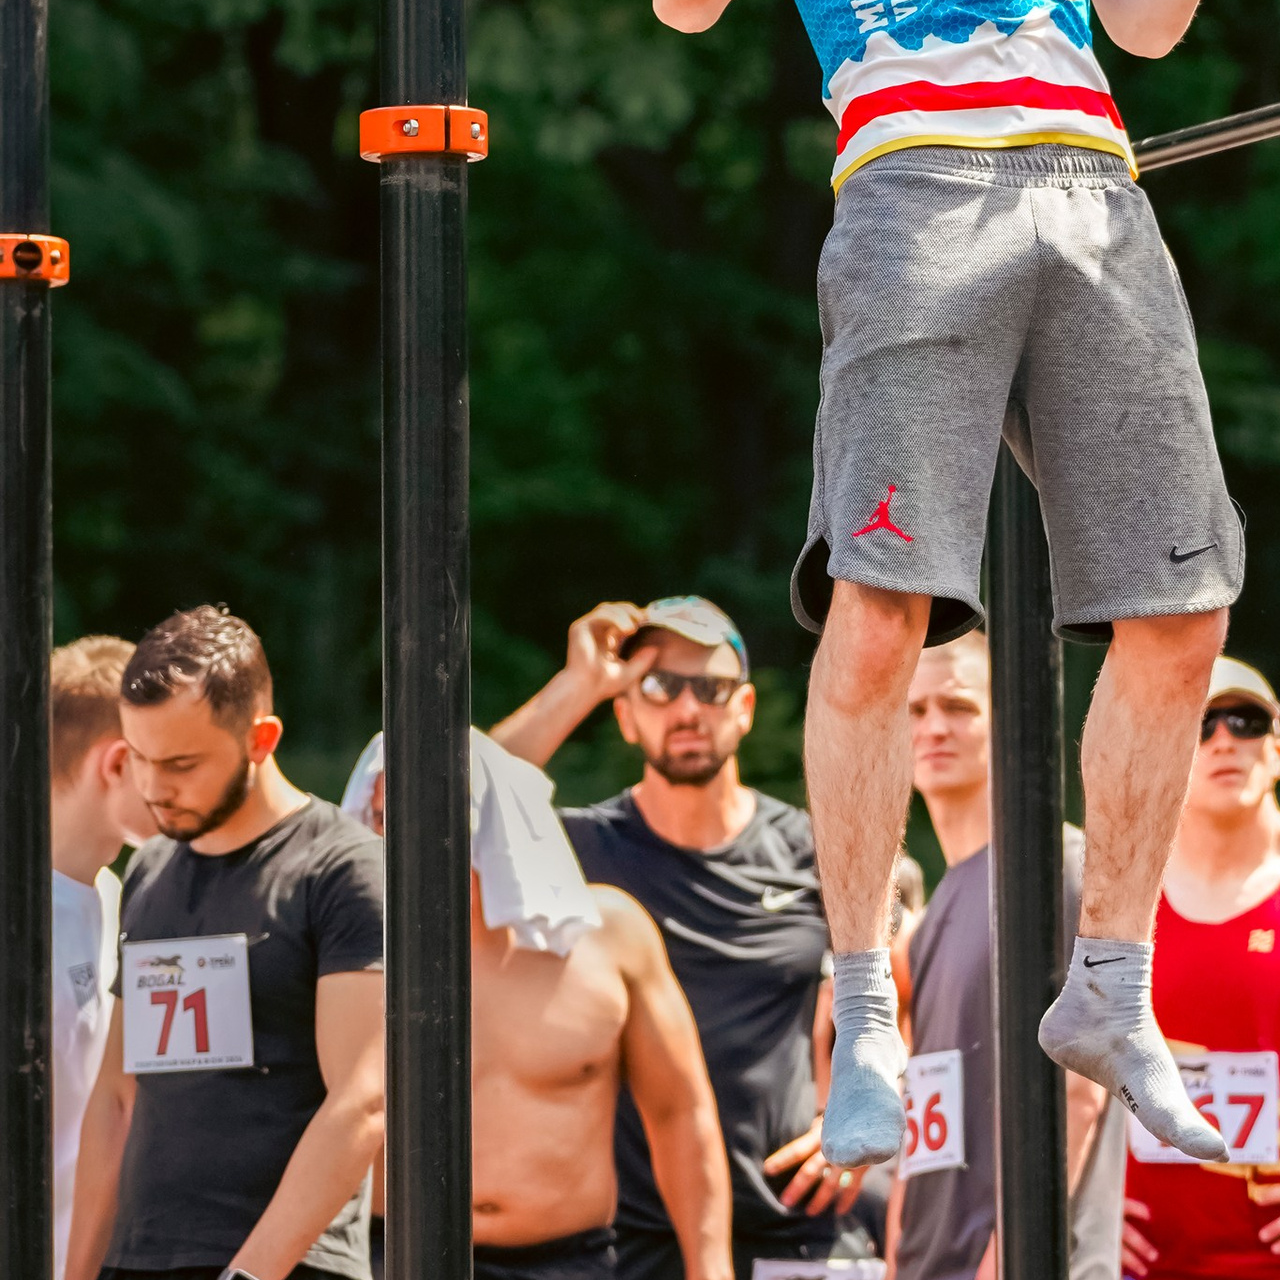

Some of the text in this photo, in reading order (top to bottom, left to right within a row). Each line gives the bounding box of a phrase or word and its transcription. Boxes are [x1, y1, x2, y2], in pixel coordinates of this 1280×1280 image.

[136, 973, 187, 989] BOGAL
[150, 987, 210, 1056] 71
[1120, 1084, 1139, 1114] NIKE
